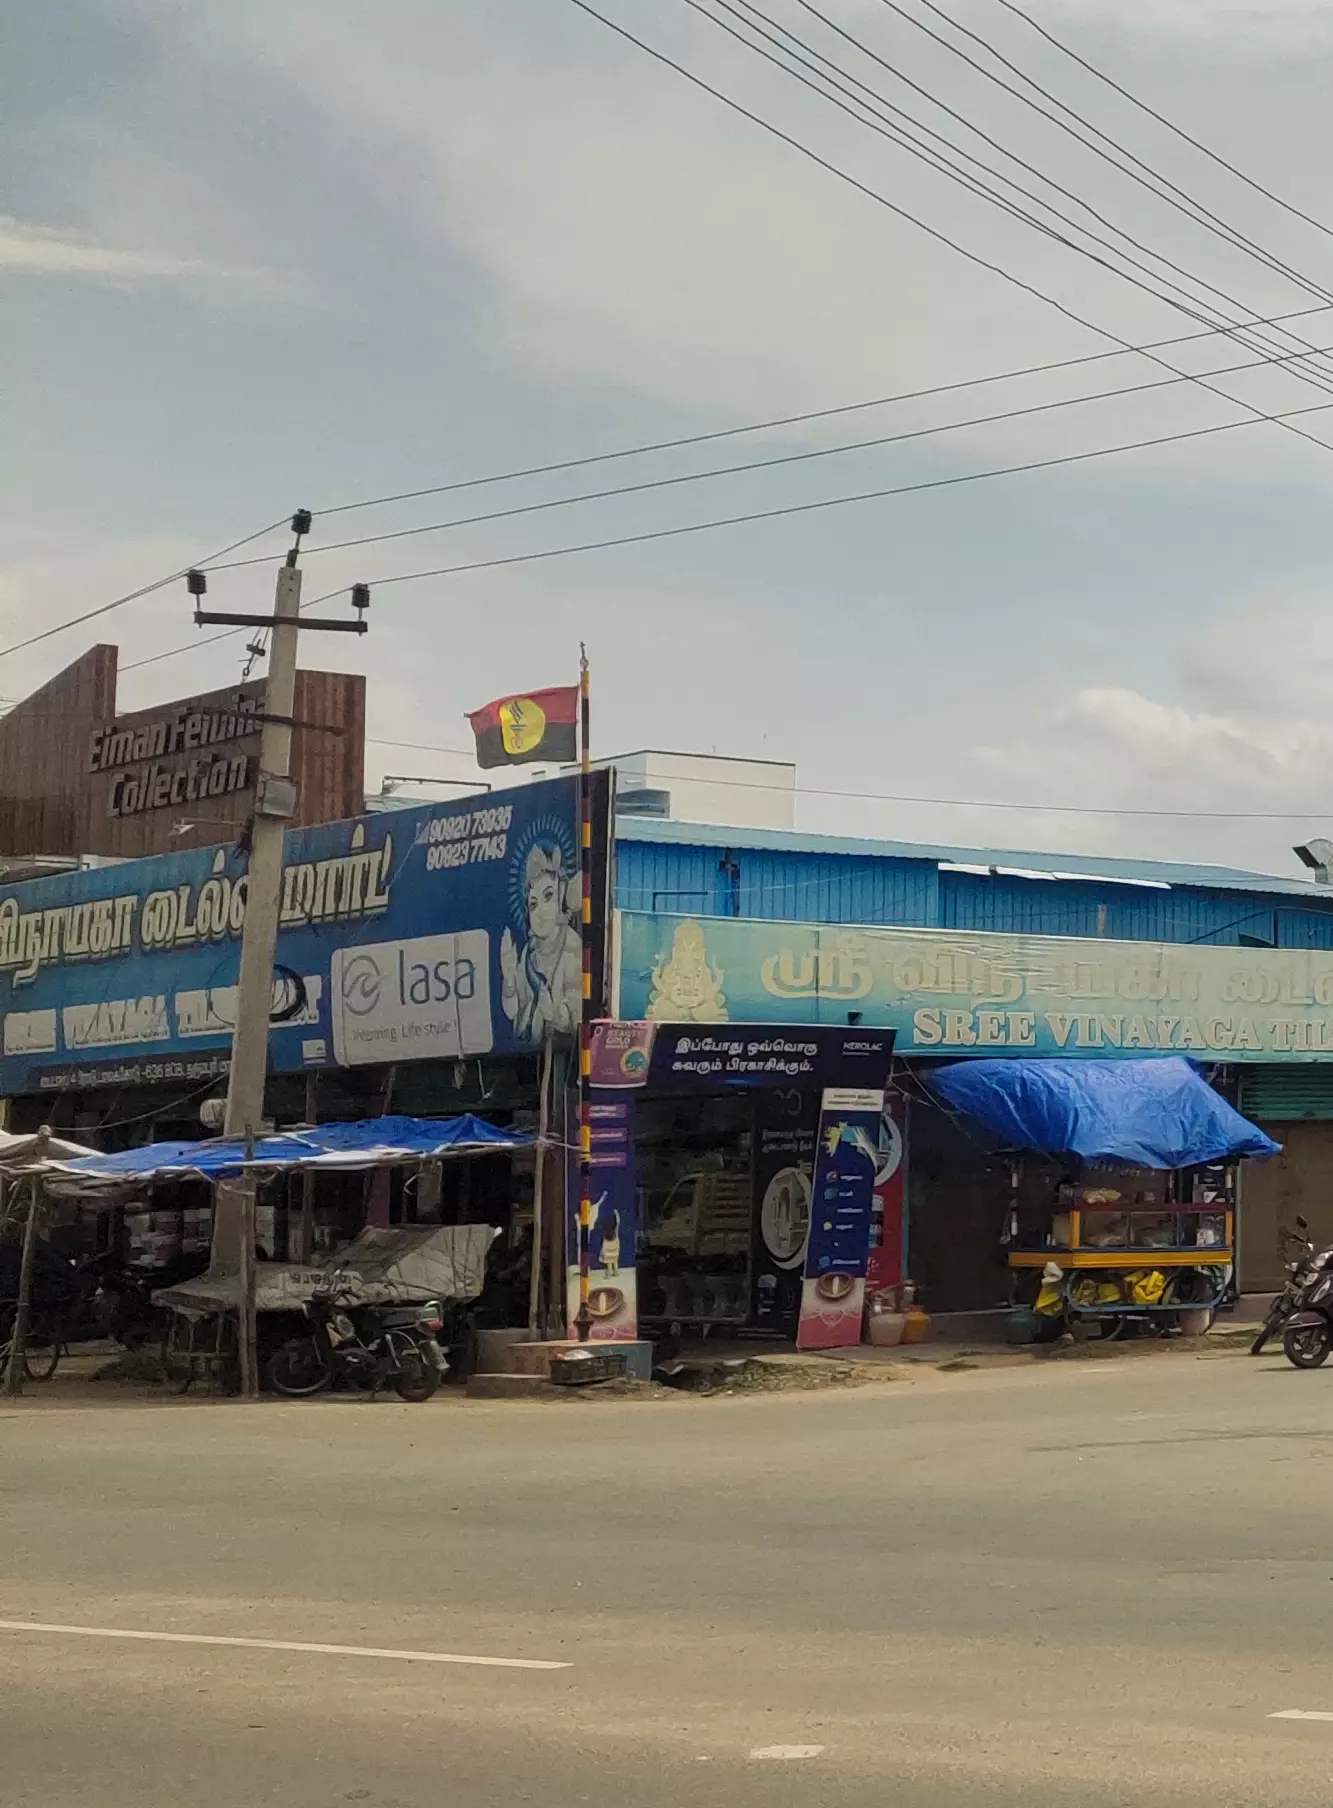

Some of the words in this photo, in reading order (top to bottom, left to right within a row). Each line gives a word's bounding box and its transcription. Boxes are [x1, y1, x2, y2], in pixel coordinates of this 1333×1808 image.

[89, 721, 167, 773] Eiman
[108, 753, 248, 818] Collection
[398, 949, 476, 1006] lasa
[675, 1037, 744, 1055] இப்போது
[747, 1038, 818, 1056] ஒவ்வொரு
[843, 1041, 883, 1051] NEROLAC
[912, 1006, 1037, 1048] SREE
[1045, 1012, 1263, 1052] VINAYAGA
[671, 1057, 723, 1075] சுவரும்
[725, 1057, 814, 1075] பிரகாசிக்கும்.
